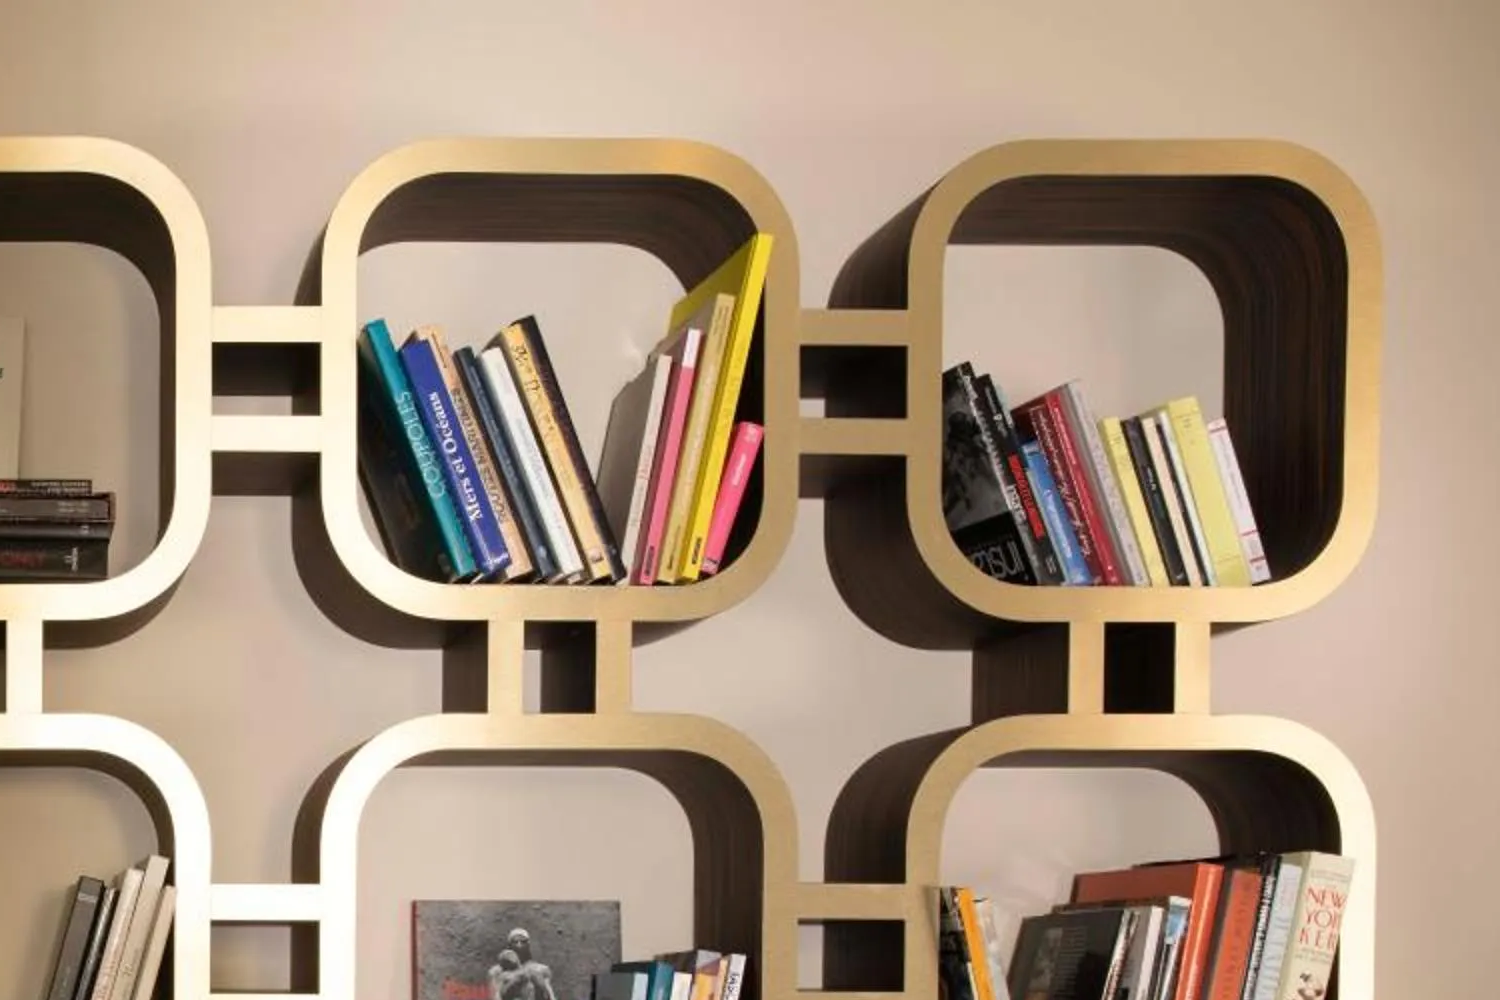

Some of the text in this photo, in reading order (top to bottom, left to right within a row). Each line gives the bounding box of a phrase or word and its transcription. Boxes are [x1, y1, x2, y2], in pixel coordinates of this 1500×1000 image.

[394, 391, 445, 498] COUPOLES
[428, 390, 458, 454] Océans
[449, 457, 467, 475] et
[459, 476, 485, 522] Mers
